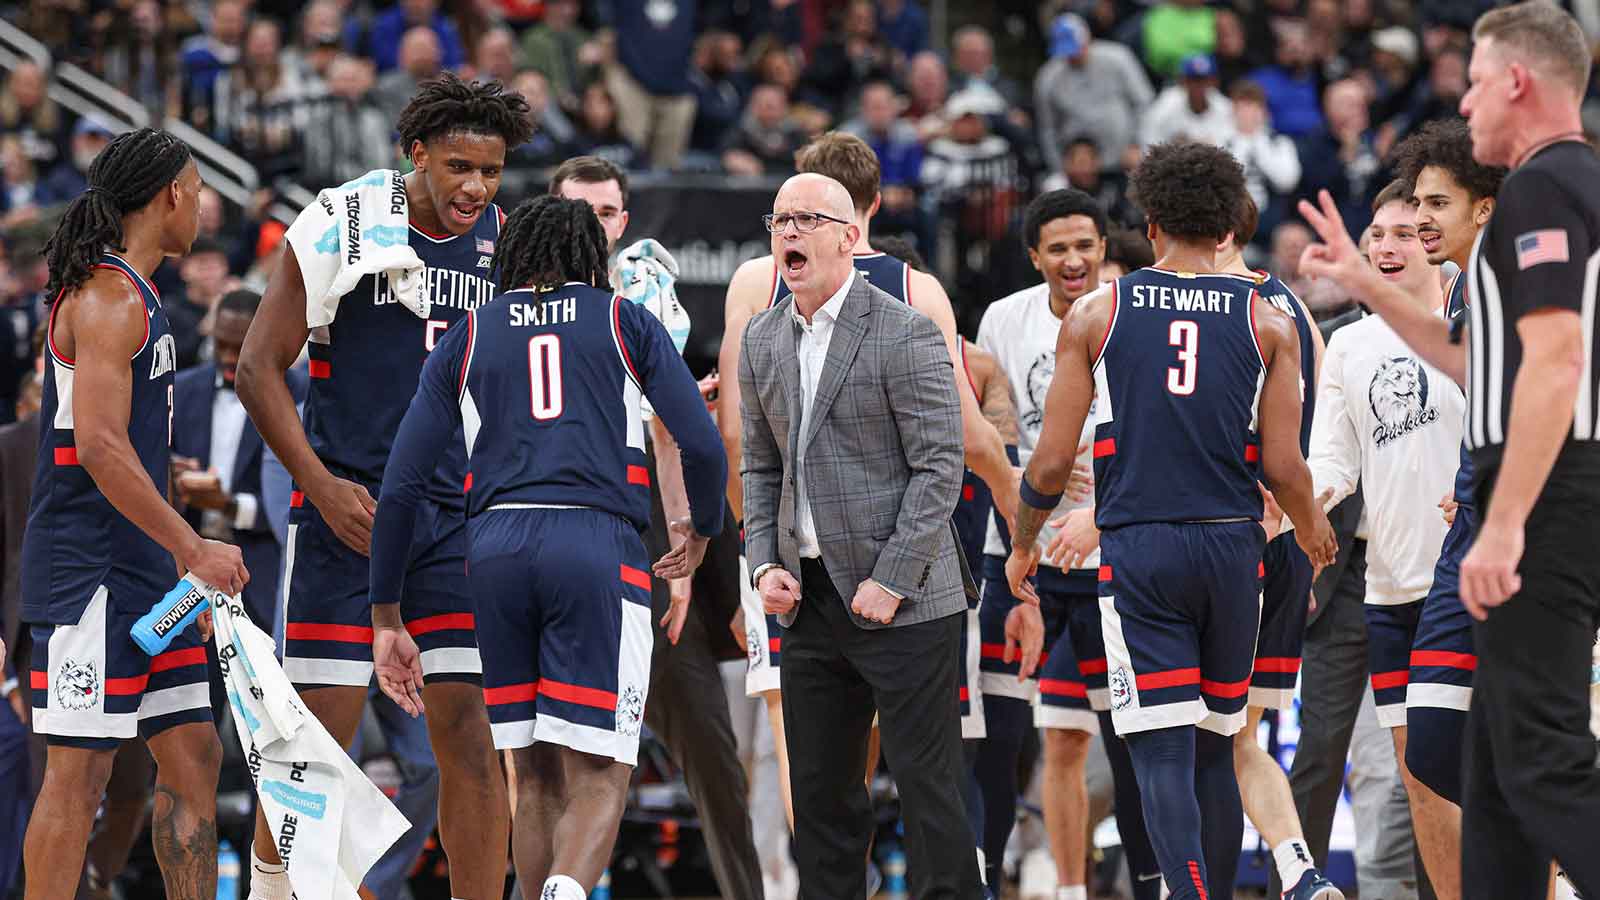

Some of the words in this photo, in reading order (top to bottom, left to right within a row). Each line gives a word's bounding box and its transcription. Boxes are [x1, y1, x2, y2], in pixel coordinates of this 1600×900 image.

[345, 192, 361, 265] OWERADE
[374, 266, 497, 311] CECTICUT
[509, 297, 577, 327] SMITH
[1132, 285, 1235, 314] STEWART
[528, 333, 563, 421] 0
[1167, 320, 1199, 396] 3
[1372, 407, 1440, 447] Huskies
[280, 813, 298, 870] RADE
